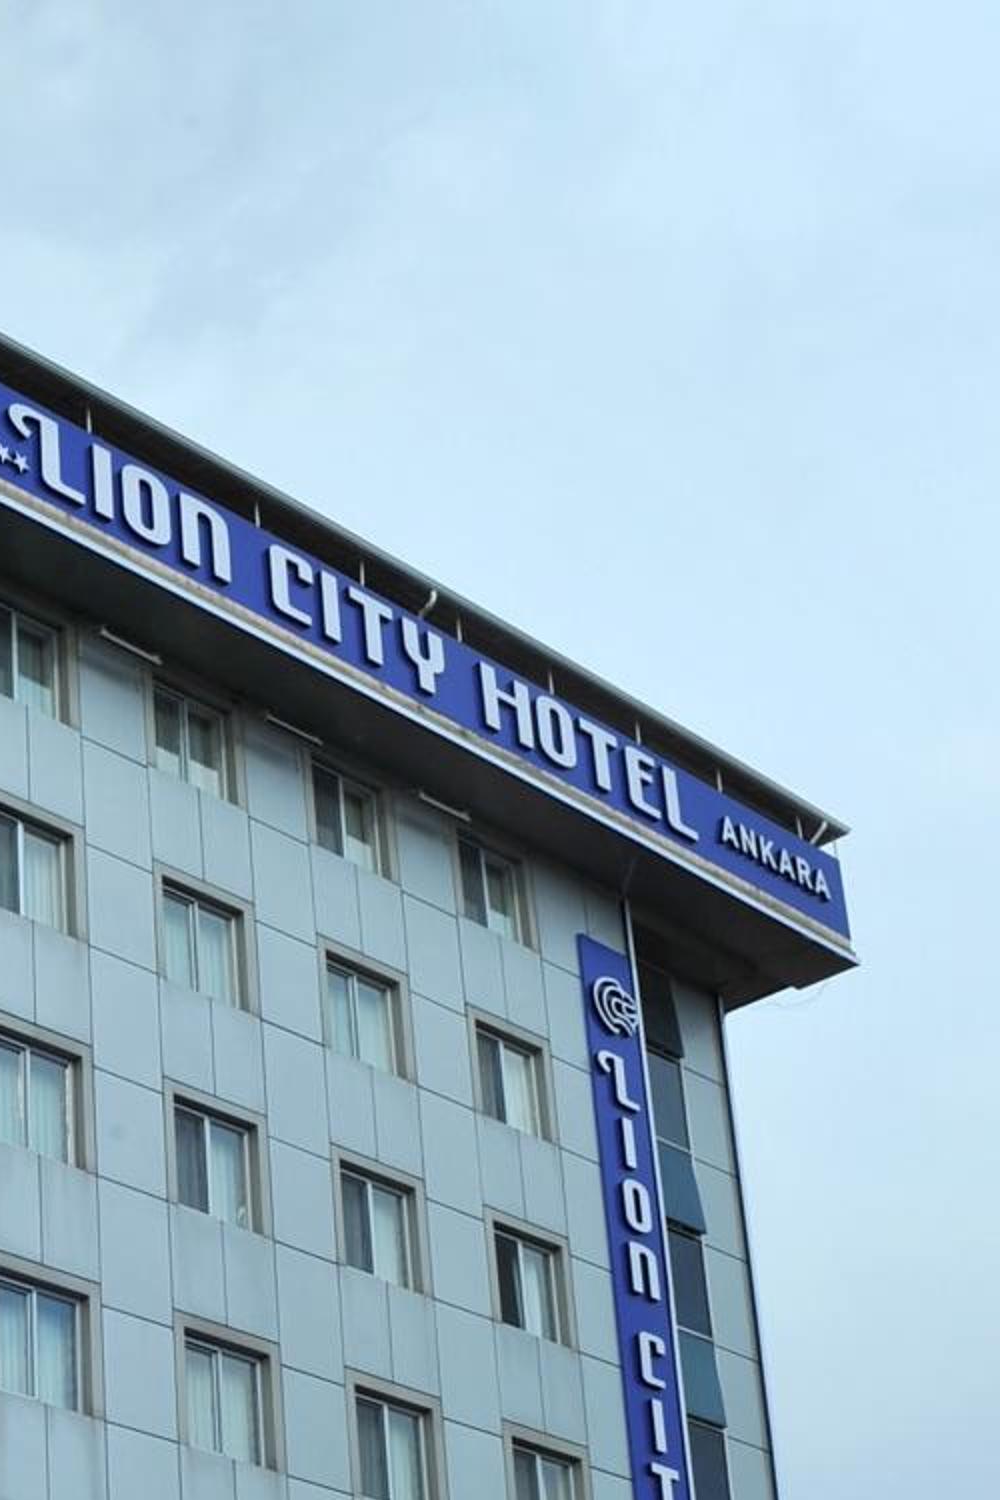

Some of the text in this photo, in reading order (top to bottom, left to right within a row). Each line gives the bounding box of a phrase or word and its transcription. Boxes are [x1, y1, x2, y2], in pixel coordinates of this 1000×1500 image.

[8, 403, 831, 900] LION CITY HOTEL ANKARA
[596, 1049, 662, 1302] LION
